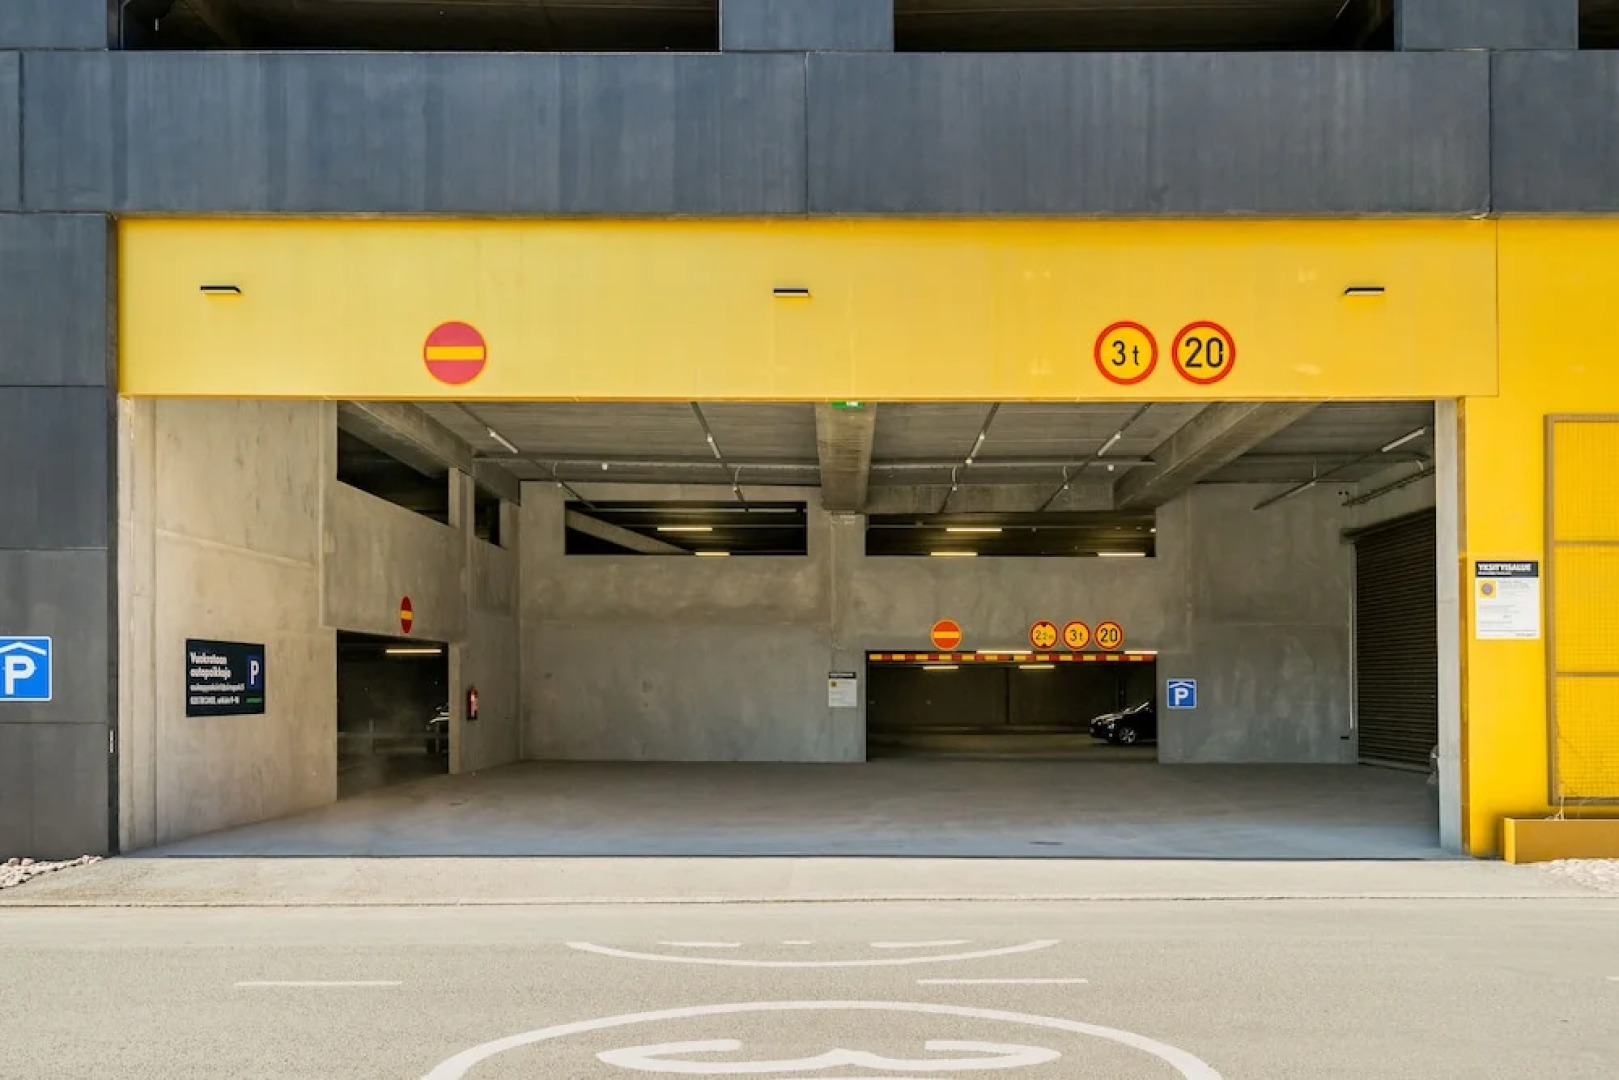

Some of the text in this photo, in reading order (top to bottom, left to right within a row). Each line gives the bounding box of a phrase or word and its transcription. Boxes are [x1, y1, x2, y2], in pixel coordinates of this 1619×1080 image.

[1111, 340, 1140, 366] 3 t
[1185, 337, 1224, 368] 20
[1069, 629, 1077, 642] 3
[1100, 628, 1118, 642] 20
[5, 655, 35, 696] P
[250, 660, 260, 686] P
[1174, 687, 1189, 706] P
[596, 1039, 1062, 1080] 3
